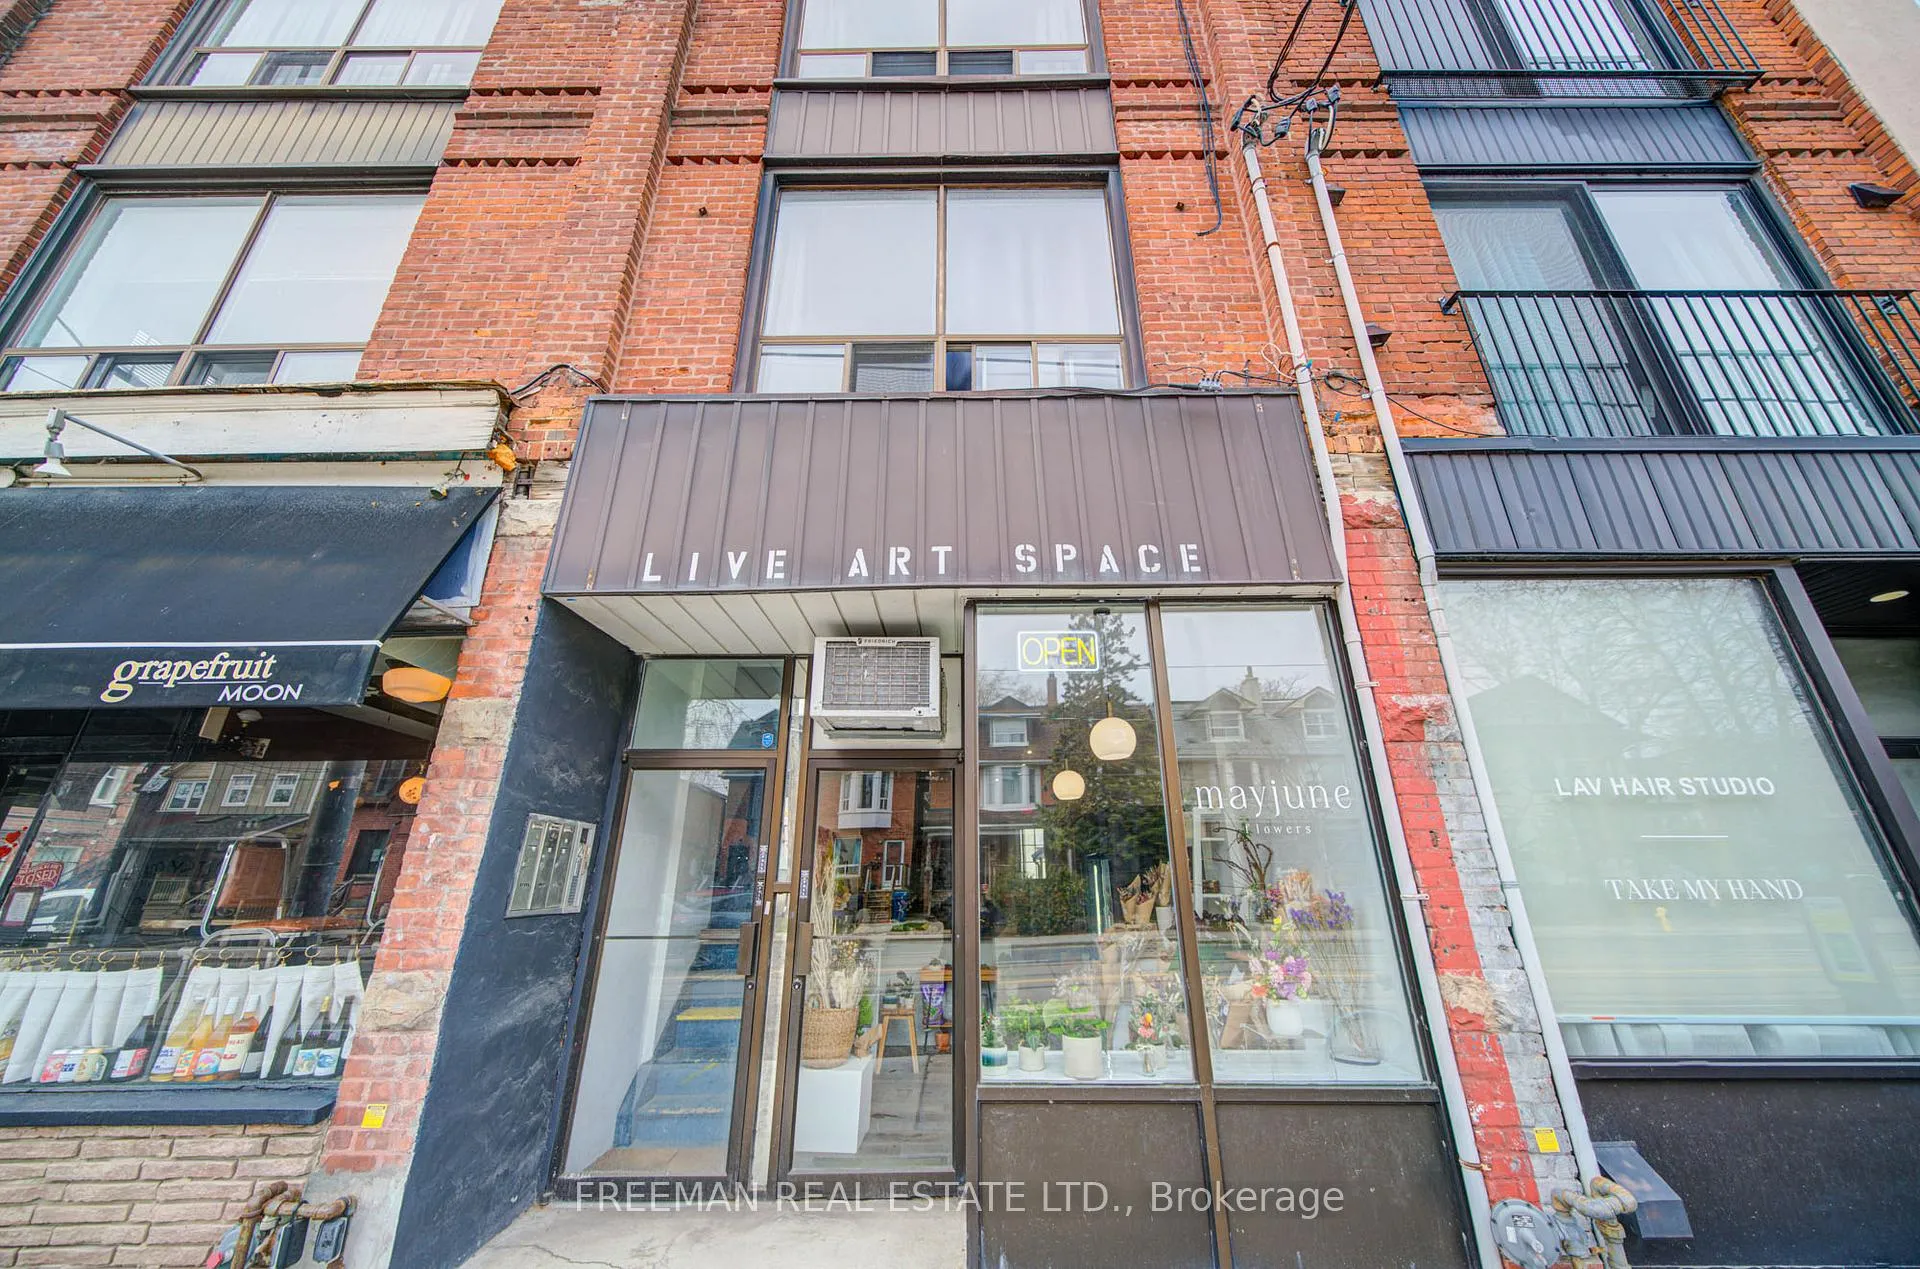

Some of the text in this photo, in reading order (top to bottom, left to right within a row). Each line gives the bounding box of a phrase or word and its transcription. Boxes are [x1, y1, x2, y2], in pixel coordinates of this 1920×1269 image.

[643, 543, 1201, 582] LIVE ART SPACE
[1022, 636, 1096, 665] OPEN
[100, 651, 277, 703] grapefruit
[217, 684, 304, 702] MOON
[1194, 780, 1352, 818] mayjune
[1554, 777, 1776, 796] LAV HAIR STUDIO
[1604, 879, 1804, 900] TAKE MY HAND
